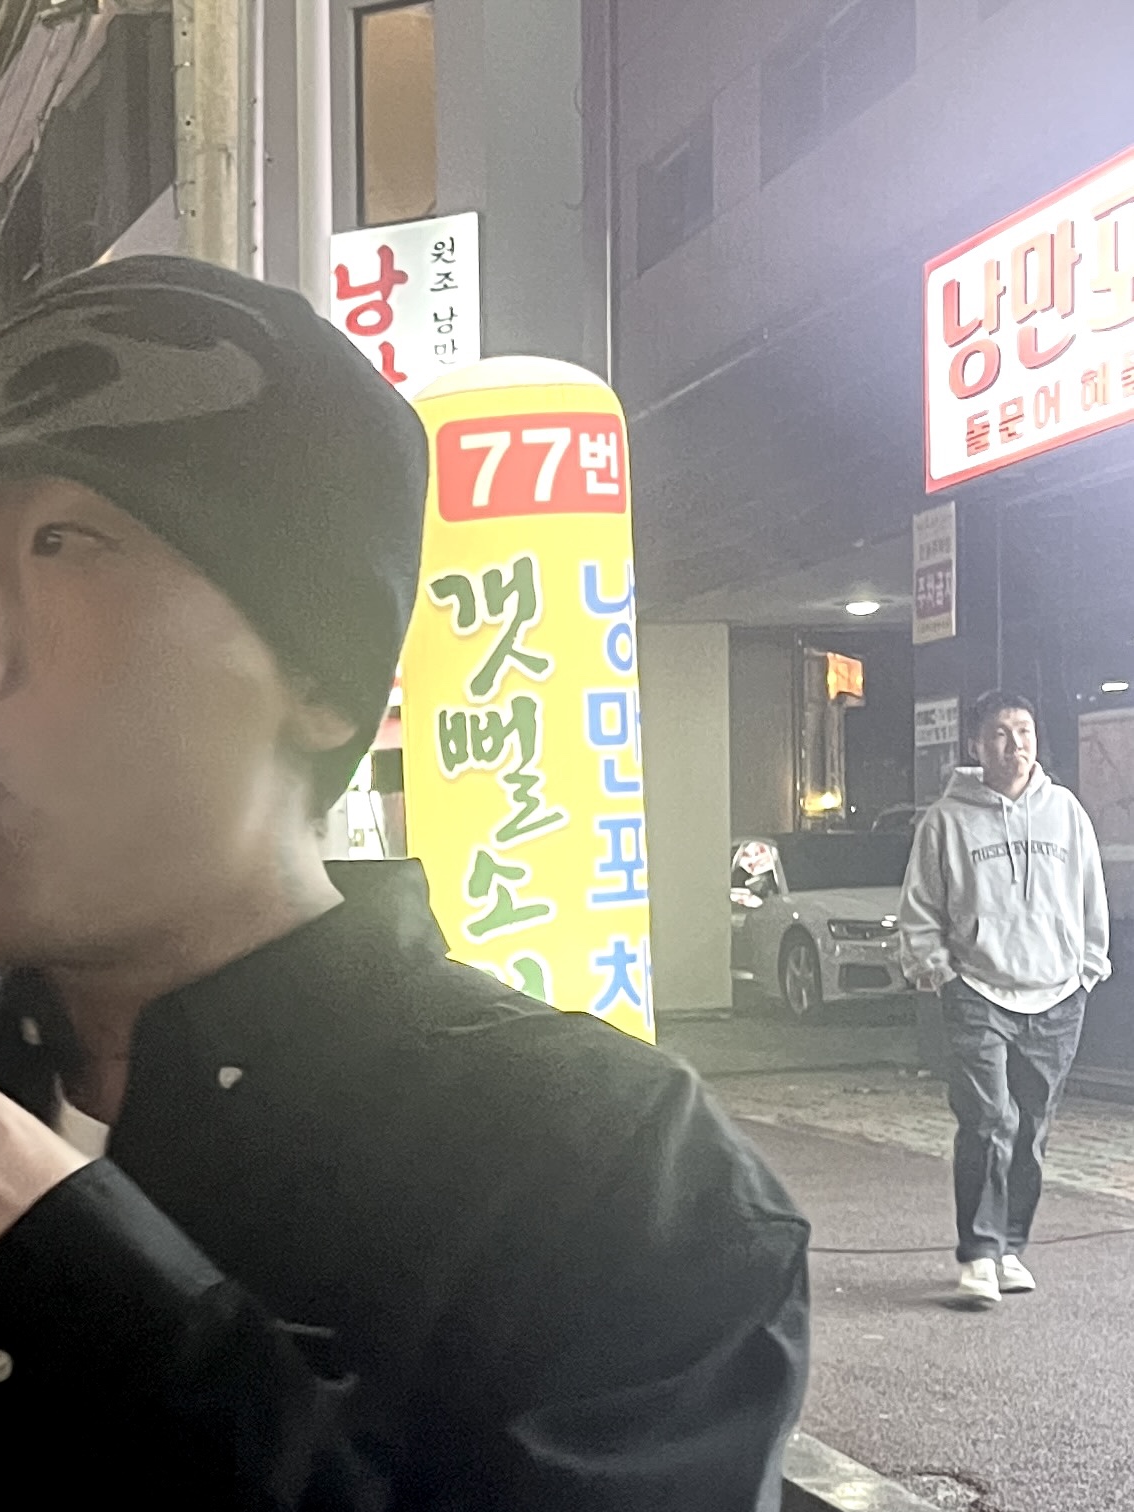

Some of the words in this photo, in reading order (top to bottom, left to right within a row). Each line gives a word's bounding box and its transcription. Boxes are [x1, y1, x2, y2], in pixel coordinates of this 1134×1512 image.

[430, 236, 458, 293] 원조
[460, 427, 619, 508] 77번
[431, 555, 564, 1002] 갯뻘소
